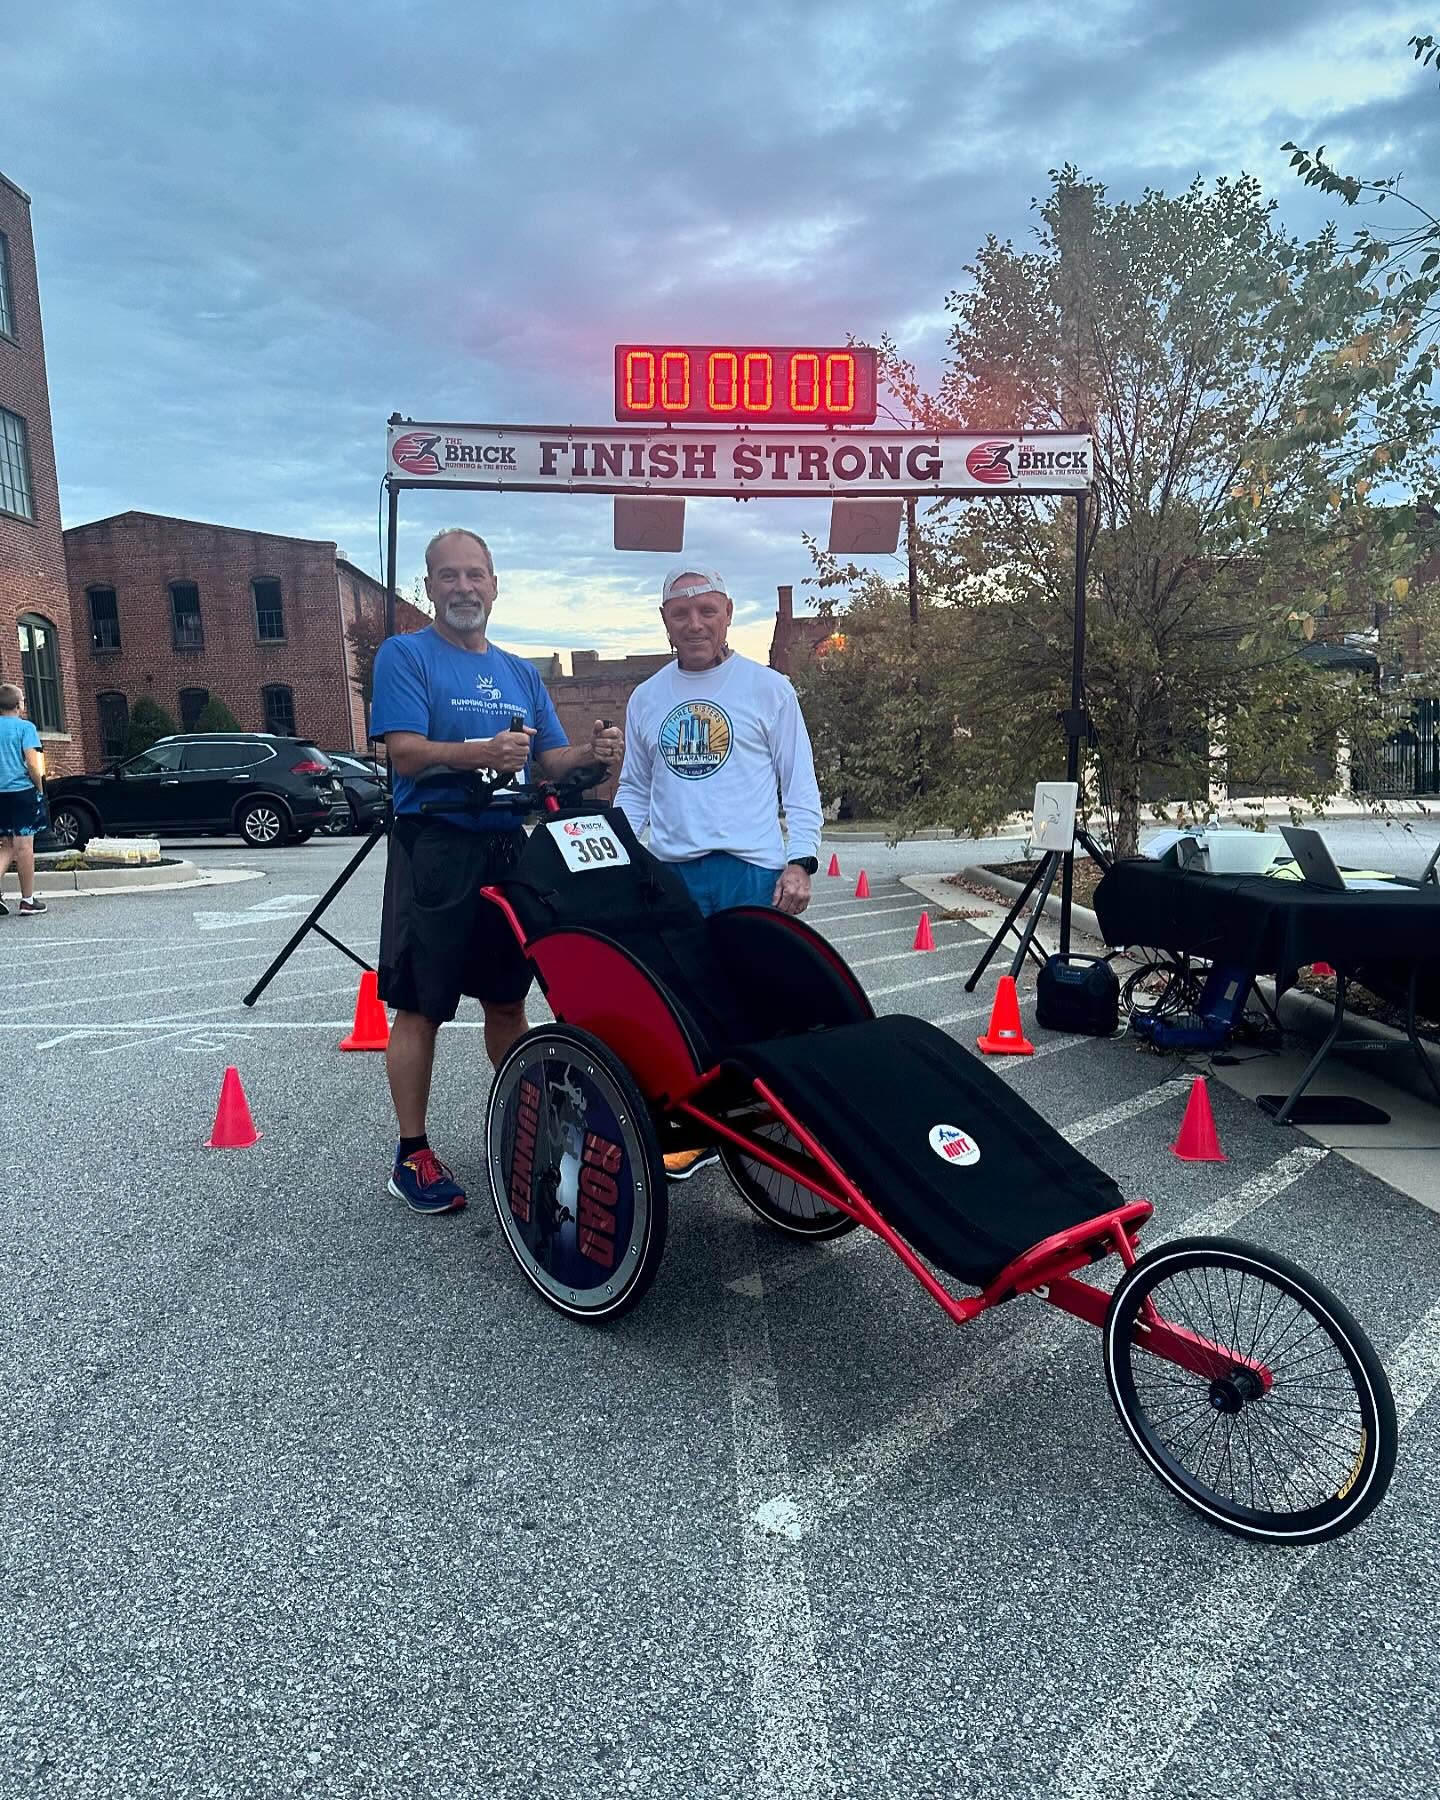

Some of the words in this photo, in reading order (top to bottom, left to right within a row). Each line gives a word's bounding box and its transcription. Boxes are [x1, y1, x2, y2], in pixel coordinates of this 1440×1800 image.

[445, 445, 516, 464] BRICK
[539, 442, 717, 479] FINISH
[732, 444, 944, 481] STRONG
[1017, 452, 1088, 469] BRICK
[451, 699, 483, 709] RUNNING
[669, 706, 693, 725] THREE
[694, 705, 723, 724] SISTERS
[677, 753, 718, 762] MARATHON
[570, 836, 619, 864] 369
[511, 1078, 541, 1224] RUNNER
[942, 1137, 971, 1159] HOYT
[578, 1131, 622, 1269] ROAD
